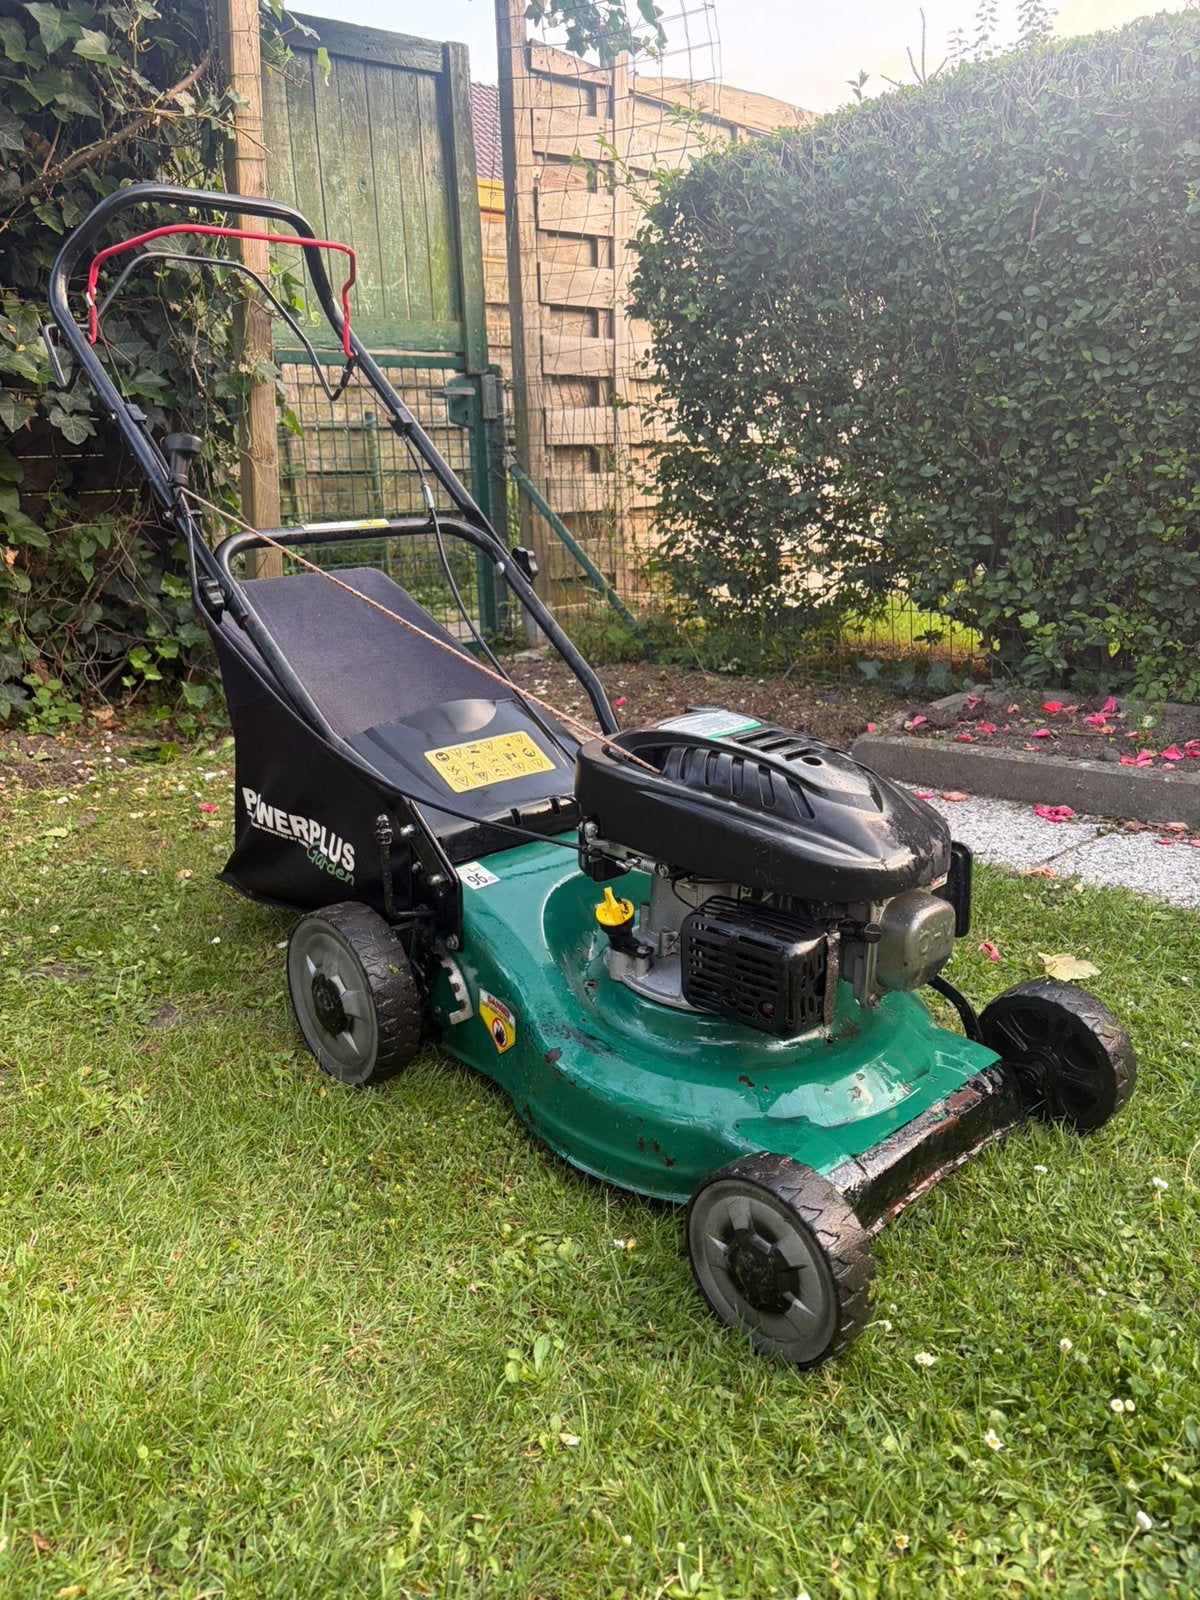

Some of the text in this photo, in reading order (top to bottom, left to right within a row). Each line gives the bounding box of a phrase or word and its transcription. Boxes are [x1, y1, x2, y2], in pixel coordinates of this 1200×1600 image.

[242, 787, 355, 872] PWERPLUS
[306, 840, 355, 887] Garden
[467, 873, 488, 886] 96
